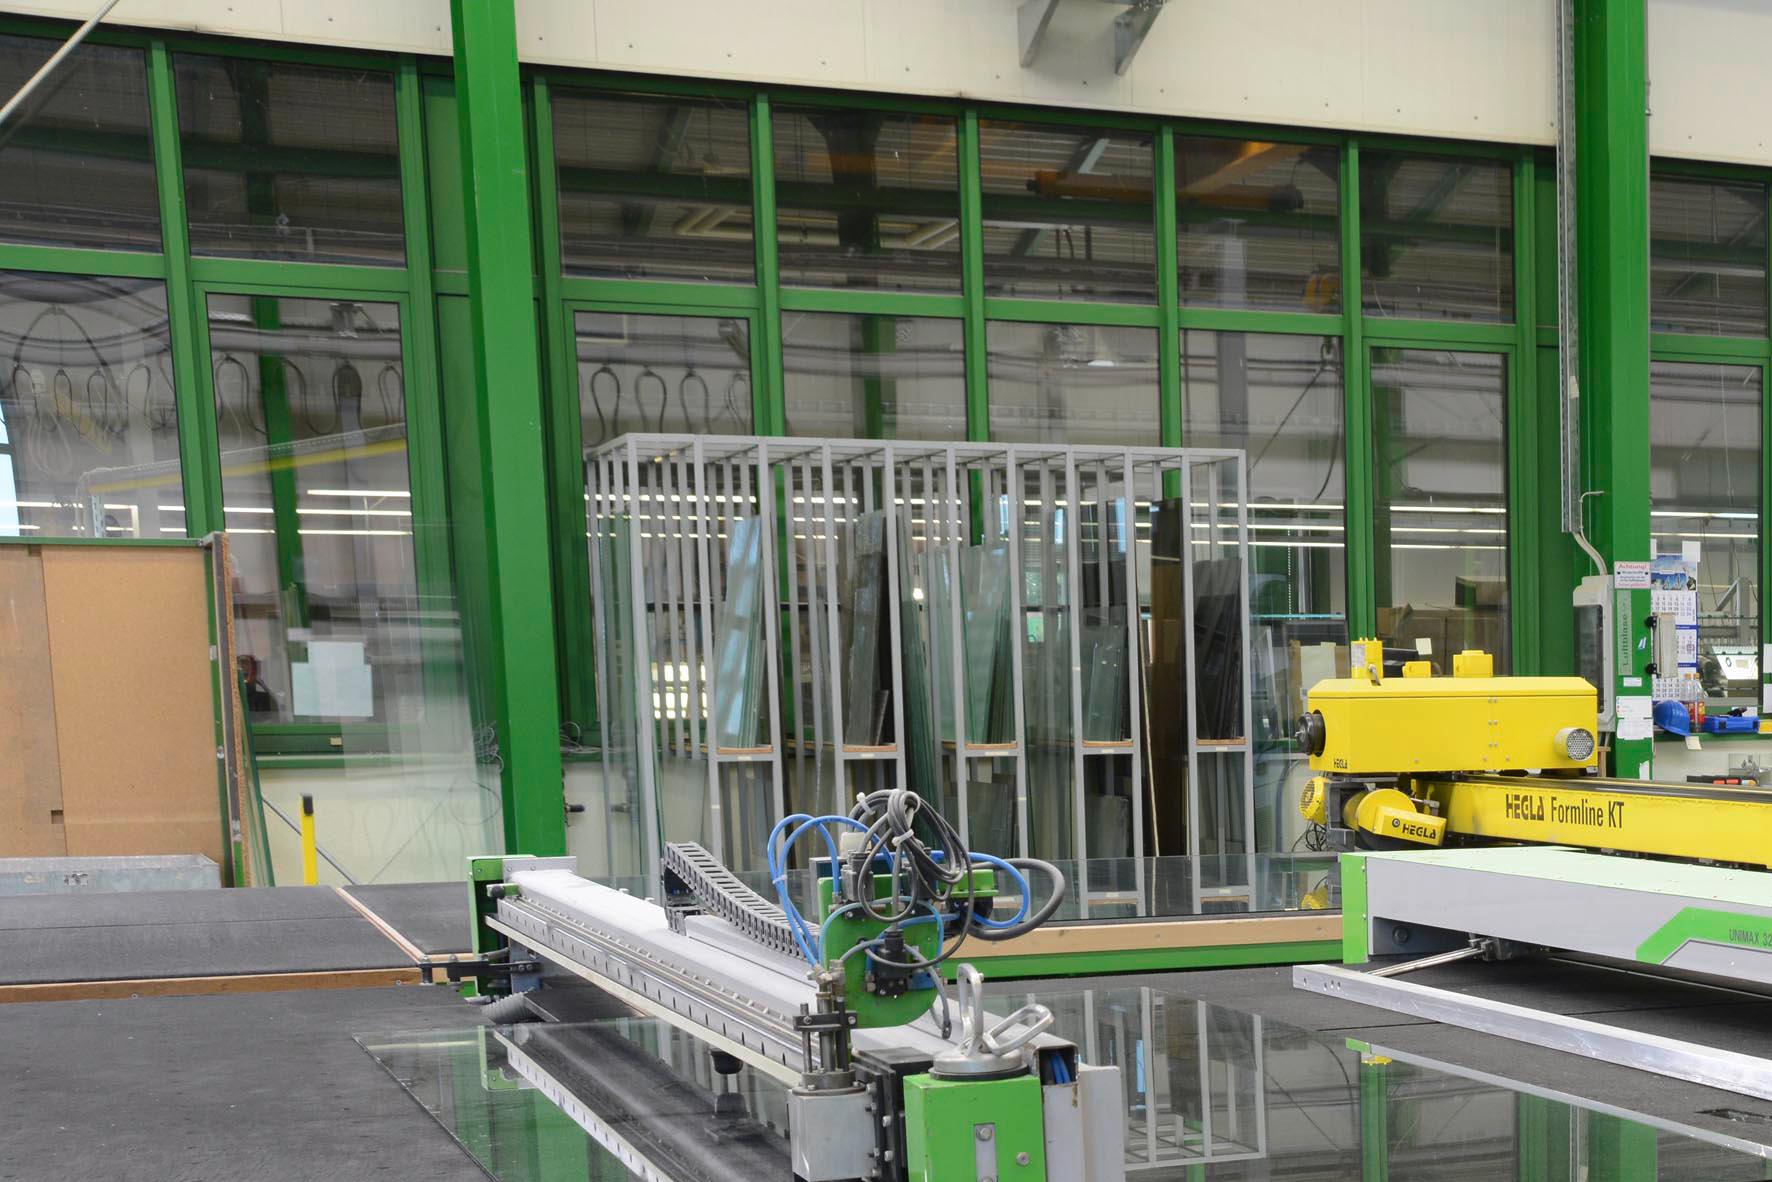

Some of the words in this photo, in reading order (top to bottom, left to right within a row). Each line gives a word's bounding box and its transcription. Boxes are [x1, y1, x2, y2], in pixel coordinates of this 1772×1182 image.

[1333, 758, 1348, 769] HEGLA
[1505, 793, 1545, 821] HEGLA
[1551, 797, 1604, 827] Formline
[1608, 801, 1625, 829] KT
[1402, 823, 1437, 840] HEGLA
[1728, 928, 1760, 945] UNIMAX
